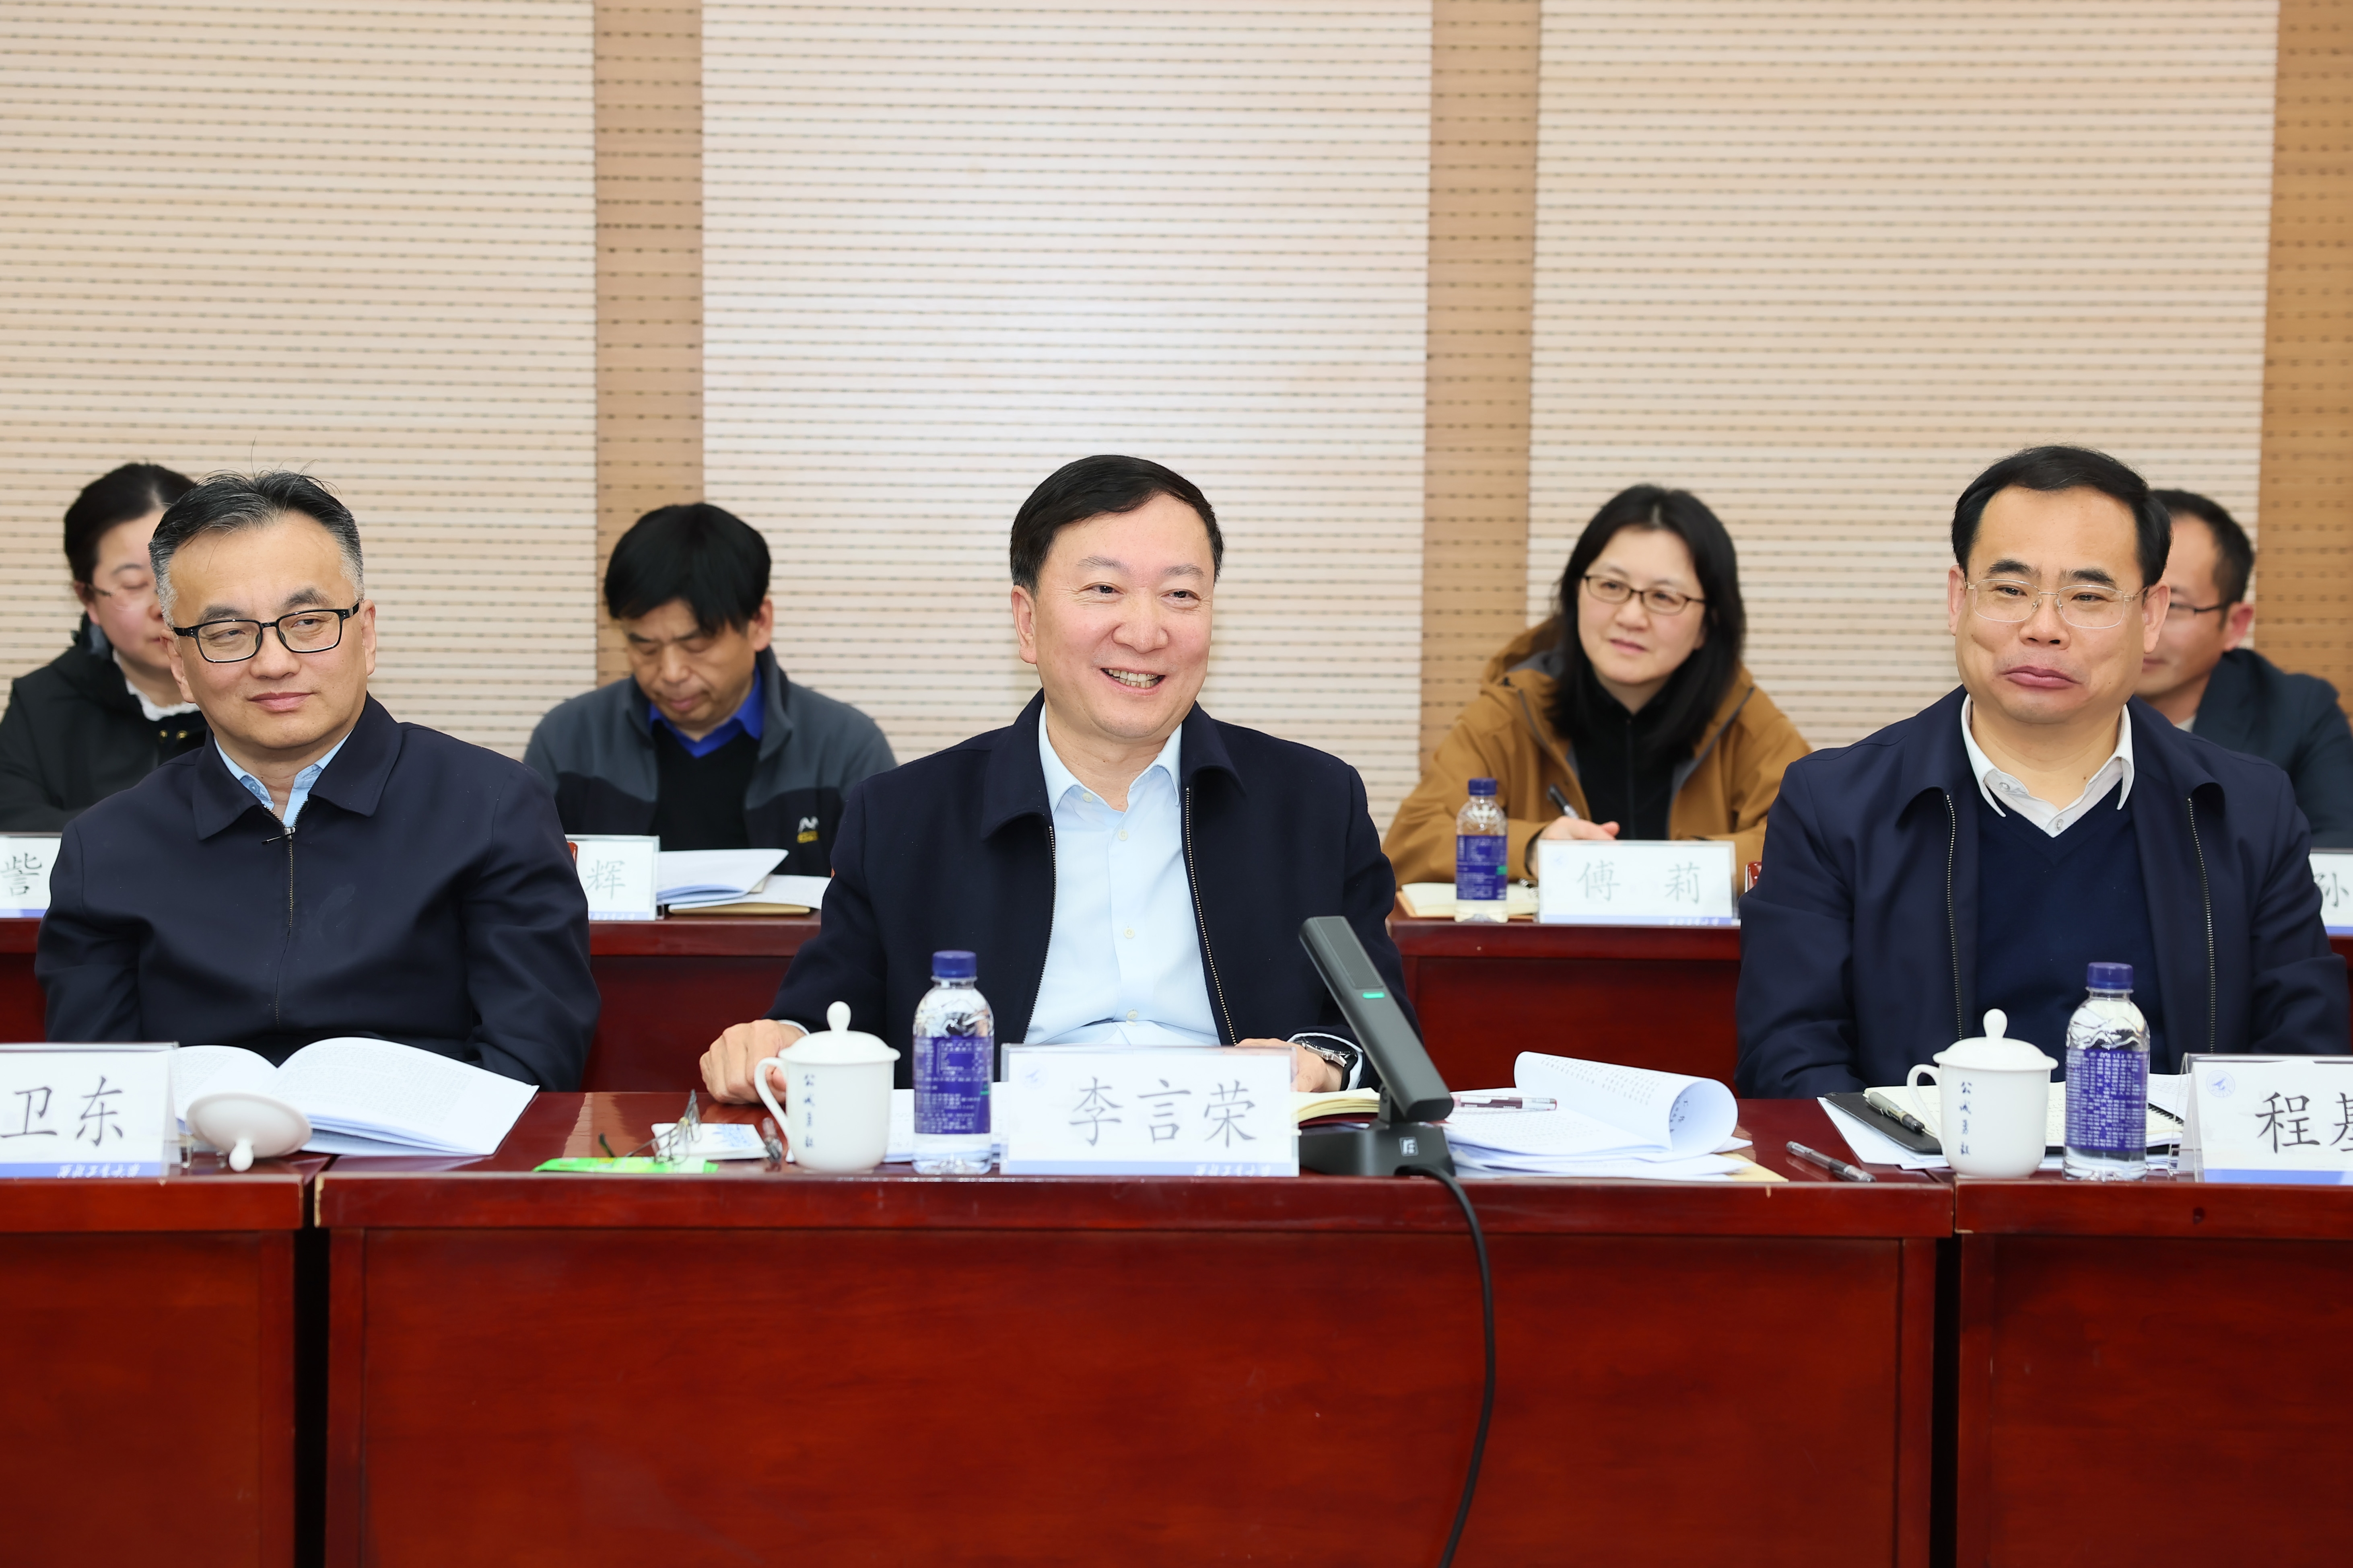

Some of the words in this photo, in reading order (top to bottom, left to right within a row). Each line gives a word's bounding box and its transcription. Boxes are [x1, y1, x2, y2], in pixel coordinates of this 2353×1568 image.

[0, 852, 43, 897] 訾
[585, 859, 626, 900] 辉
[1577, 859, 1701, 904] 傅莉
[0, 1075, 124, 1147] 卫东
[1069, 1076, 1257, 1148] 李言荣
